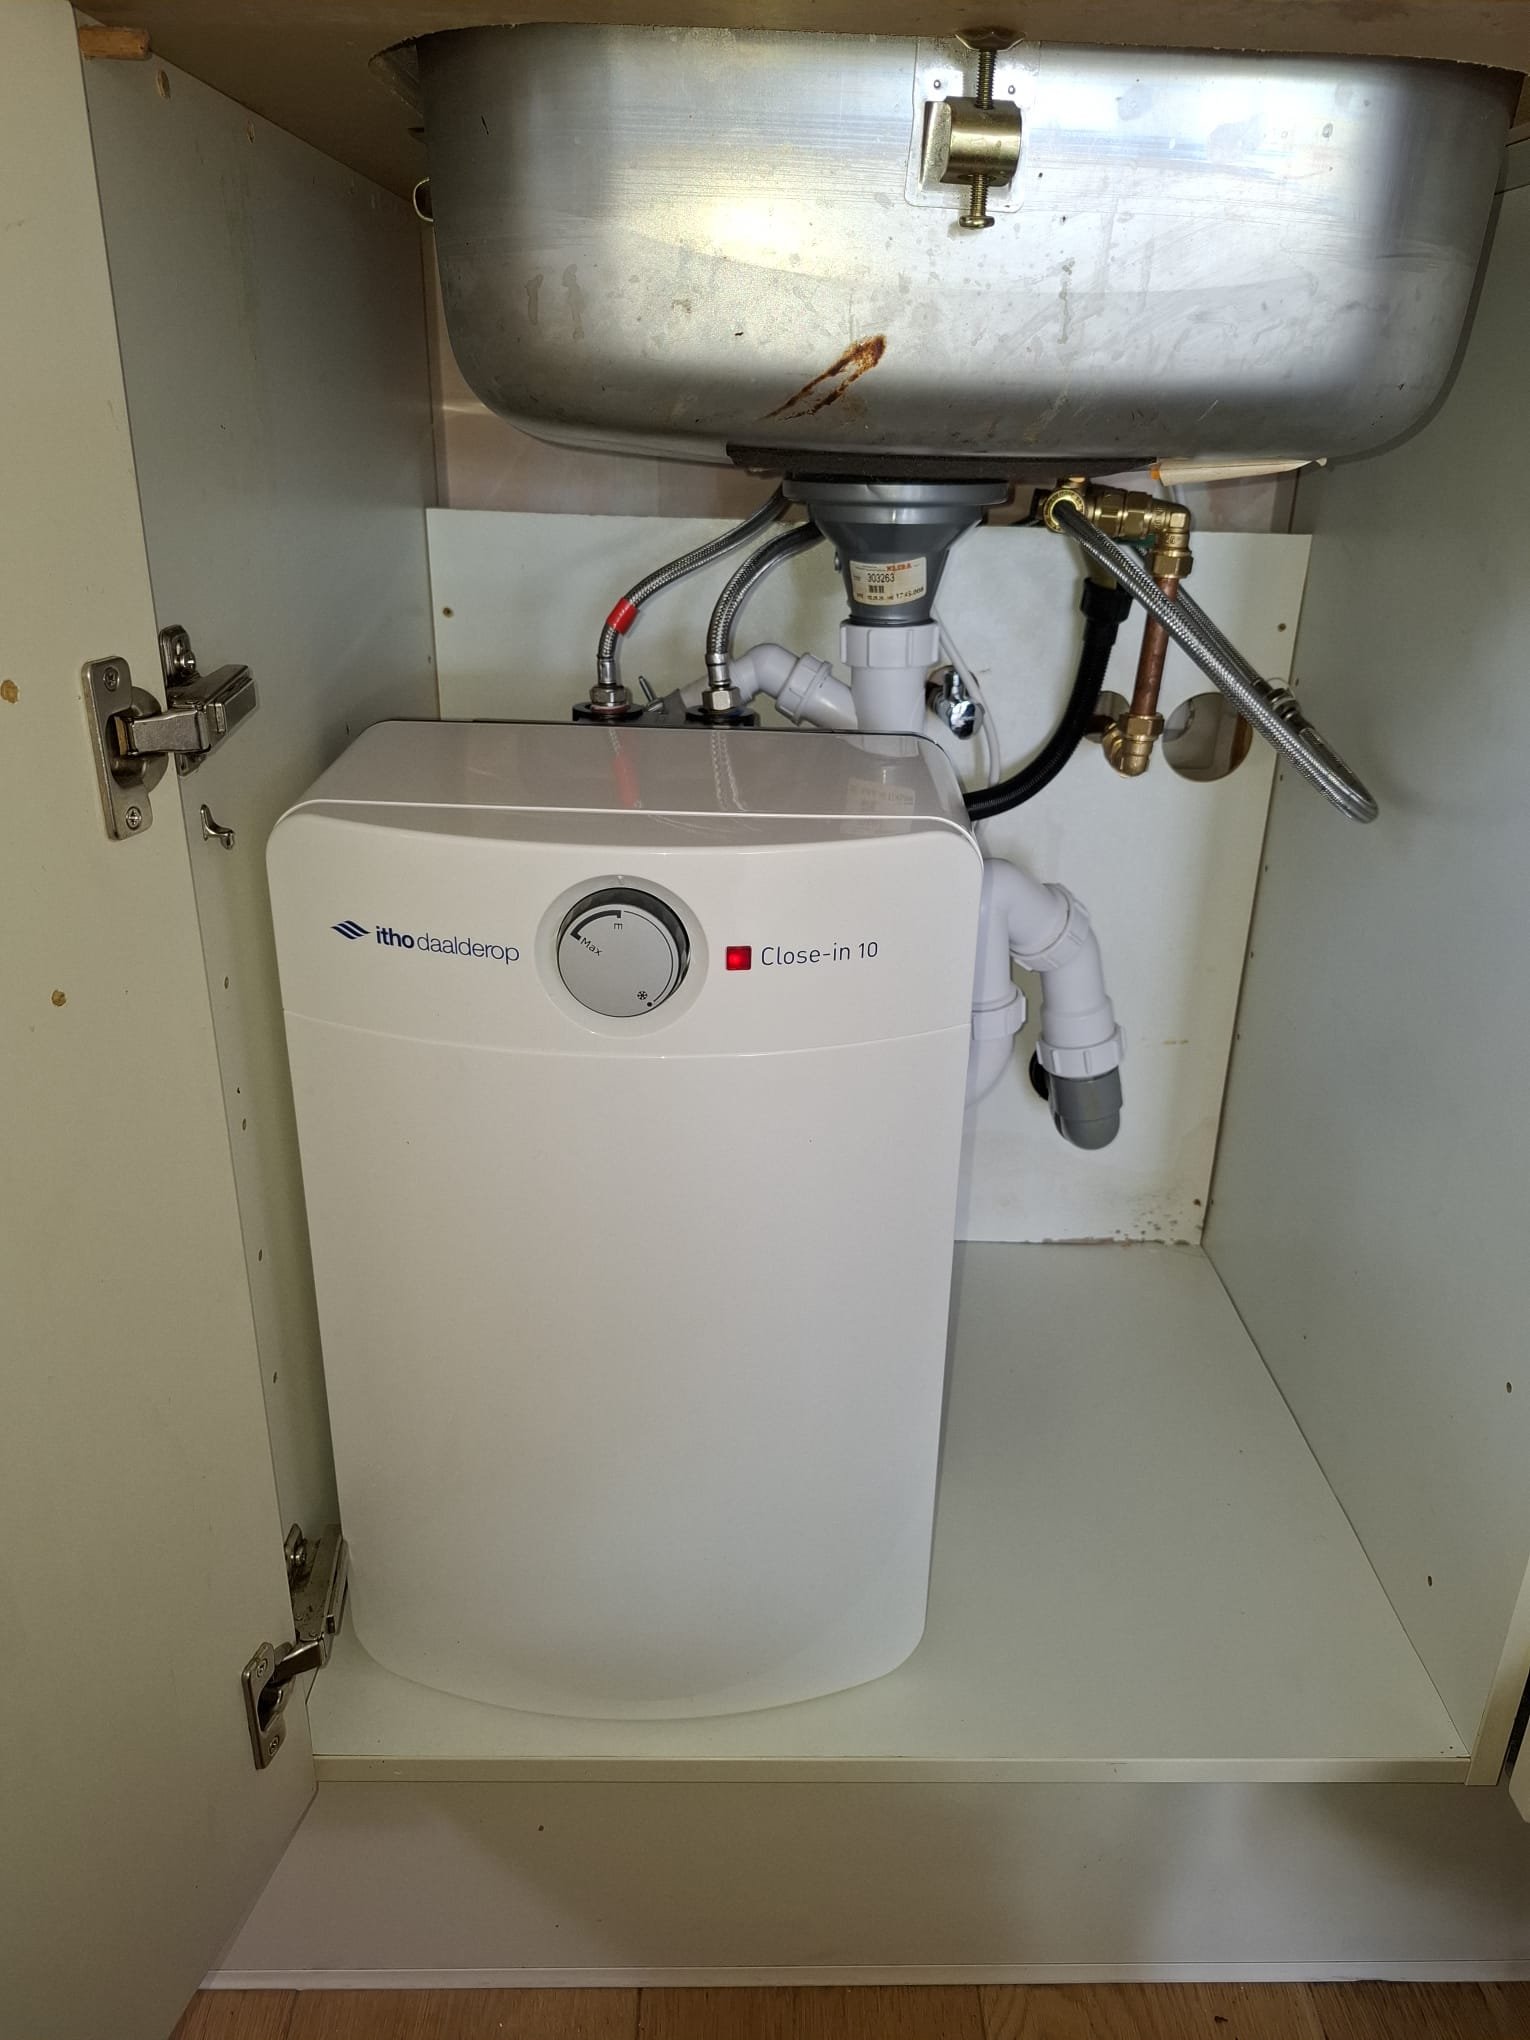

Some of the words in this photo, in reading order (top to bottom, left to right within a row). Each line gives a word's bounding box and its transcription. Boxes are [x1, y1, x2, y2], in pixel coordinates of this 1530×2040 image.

[868, 573, 895, 583] 303263
[580, 937, 603, 957] Max
[761, 942, 851, 966] Close-in
[858, 941, 878, 959] 10
